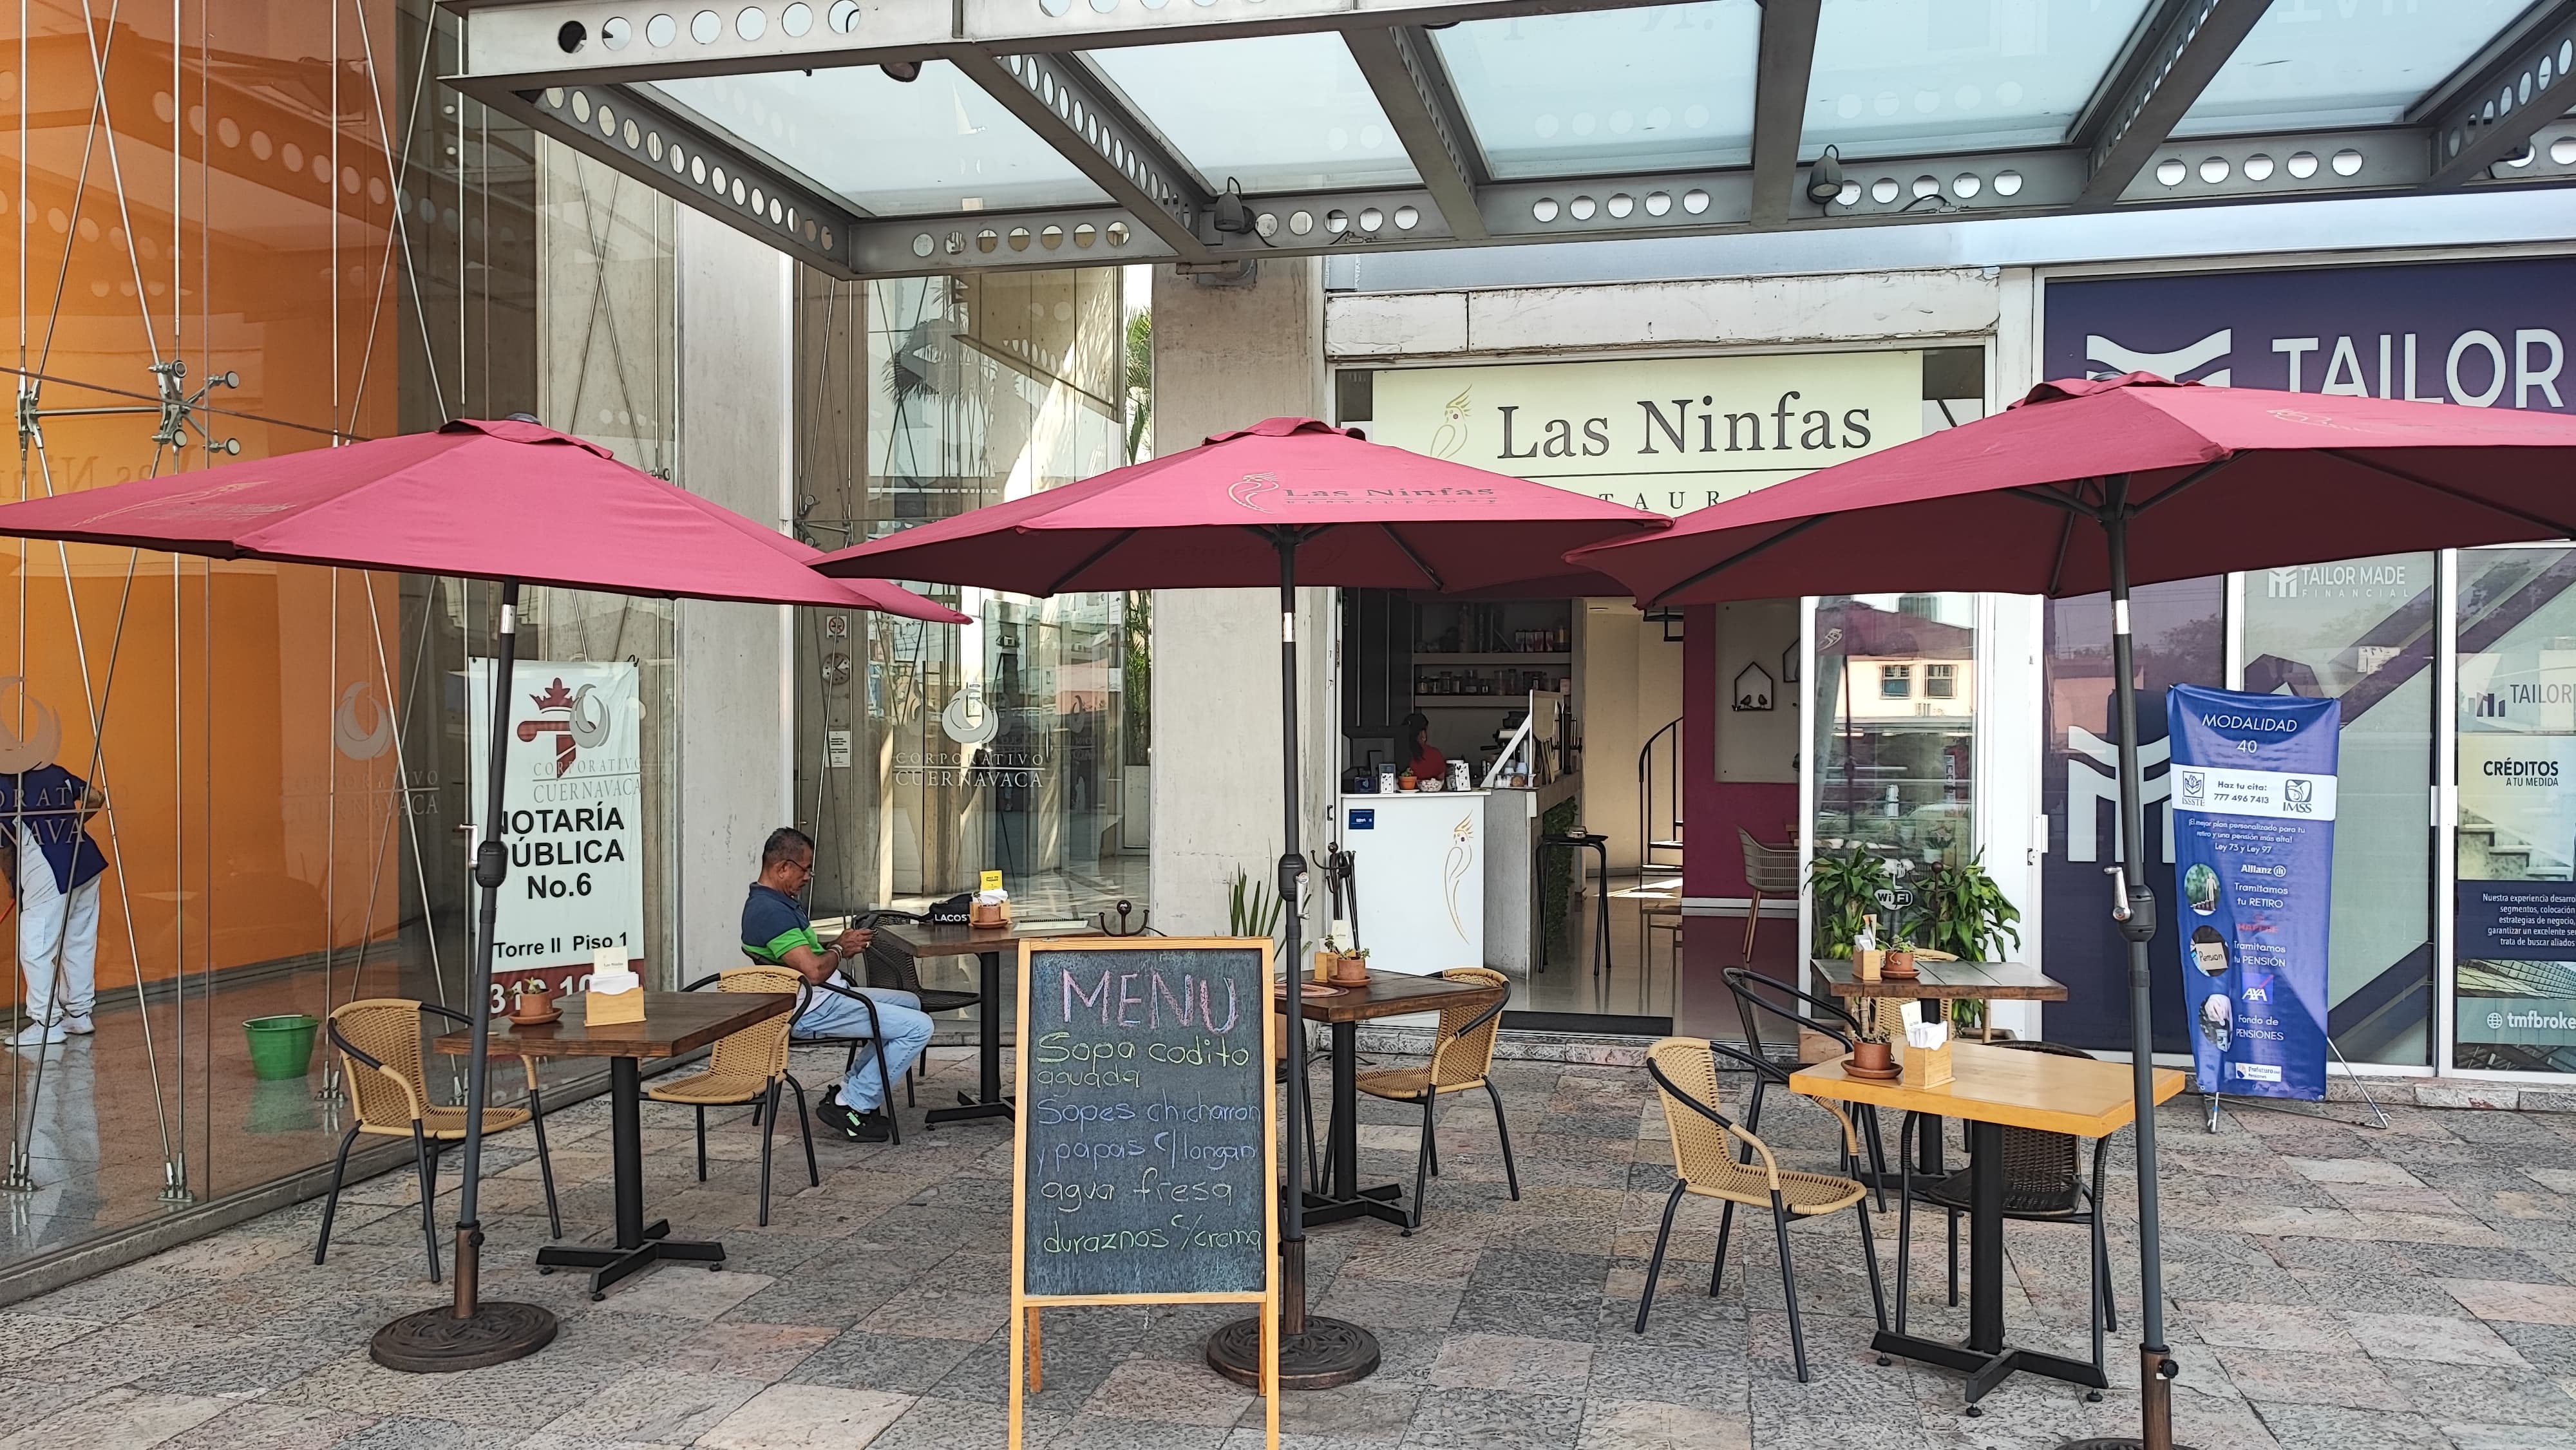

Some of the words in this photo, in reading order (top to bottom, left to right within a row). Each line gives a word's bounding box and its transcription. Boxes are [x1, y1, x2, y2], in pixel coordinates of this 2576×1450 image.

[2273, 329, 2564, 407] TAILOR
[1497, 406, 1610, 459] Las
[1637, 391, 1871, 455] Ninfas
[1283, 489, 1350, 497] Las
[1366, 487, 1495, 497] Ninfas
[2301, 566, 2355, 585] TAILOR
[2360, 566, 2406, 585] MADE
[2302, 588, 2409, 598] FINANCIAL
[2510, 684, 2572, 704] TAILOR
[2202, 713, 2298, 733] MODALIDAD
[2237, 740, 2258, 753] 40
[896, 752, 1043, 766] CORPORATIVO
[2483, 757, 2559, 777] CRÉDITOS
[895, 771, 1044, 788] CUERNAVACA
[2218, 780, 2234, 789] Haz
[2247, 783, 2268, 791] cita:
[2506, 778, 2512, 786] A
[2514, 778, 2523, 786] TU
[2526, 778, 2559, 787] MEDIDA
[533, 777, 641, 804] CUERNAVACA
[2182, 797, 2205, 807] ISSSTE
[2214, 793, 2230, 801] 777
[2250, 795, 2269, 804] 7413
[2283, 802, 2312, 813] IMSS
[2213, 820, 2228, 829] plan
[2229, 823, 2278, 831] personalizado
[2276, 835, 2293, 843] alta!
[512, 836, 625, 868] ÚBLICA
[2215, 842, 2228, 852] Ley
[2229, 843, 2239, 851] 73
[2247, 845, 2260, 855] Ley
[2240, 864, 2273, 875] Allianz
[527, 872, 592, 899] No.6
[2234, 882, 2289, 895] Tramitamos
[2237, 898, 2246, 906] tu
[2249, 898, 2284, 909] RETIRO
[2483, 893, 2508, 902] Nuestra
[2510, 894, 2549, 904] experiencia
[2550, 894, 2576, 903] desarro
[2500, 905, 2539, 915] segmentos,
[2540, 905, 2575, 914] colocación
[2499, 916, 2535, 926] estrategias
[2537, 916, 2545, 924] de
[2547, 917, 2576, 927] negocio,
[2488, 927, 2521, 936] garantizar
[2533, 927, 2566, 936] excelente
[493, 942, 544, 958] Torre
[573, 934, 612, 951] Piso
[620, 932, 627, 946] 1
[2234, 941, 2286, 953] Tramitamos
[2517, 937, 2526, 945] de
[2528, 937, 2550, 946] buscar
[2550, 938, 2575, 946] aliados
[2234, 955, 2240, 963] tu
[2242, 956, 2286, 967] PENSIÓN
[491, 978, 547, 1014] 31
[1061, 967, 1238, 1034] MENU
[2242, 988, 2268, 1002] AXA
[2266, 1016, 2278, 1026] de
[2236, 1028, 2284, 1041] PENSIONES
[1037, 1031, 1135, 1073] Sopa
[1149, 1035, 1250, 1068] codito
[1037, 1064, 1141, 1098] aguada
[1037, 1098, 1136, 1133] Sopes
[1147, 1088, 1262, 1124] chicharron
[1055, 1139, 1146, 1171] papas
[1041, 1181, 1115, 1213] agua
[1133, 1167, 1233, 1207] fresa
[1043, 1220, 1170, 1256] duraznos
